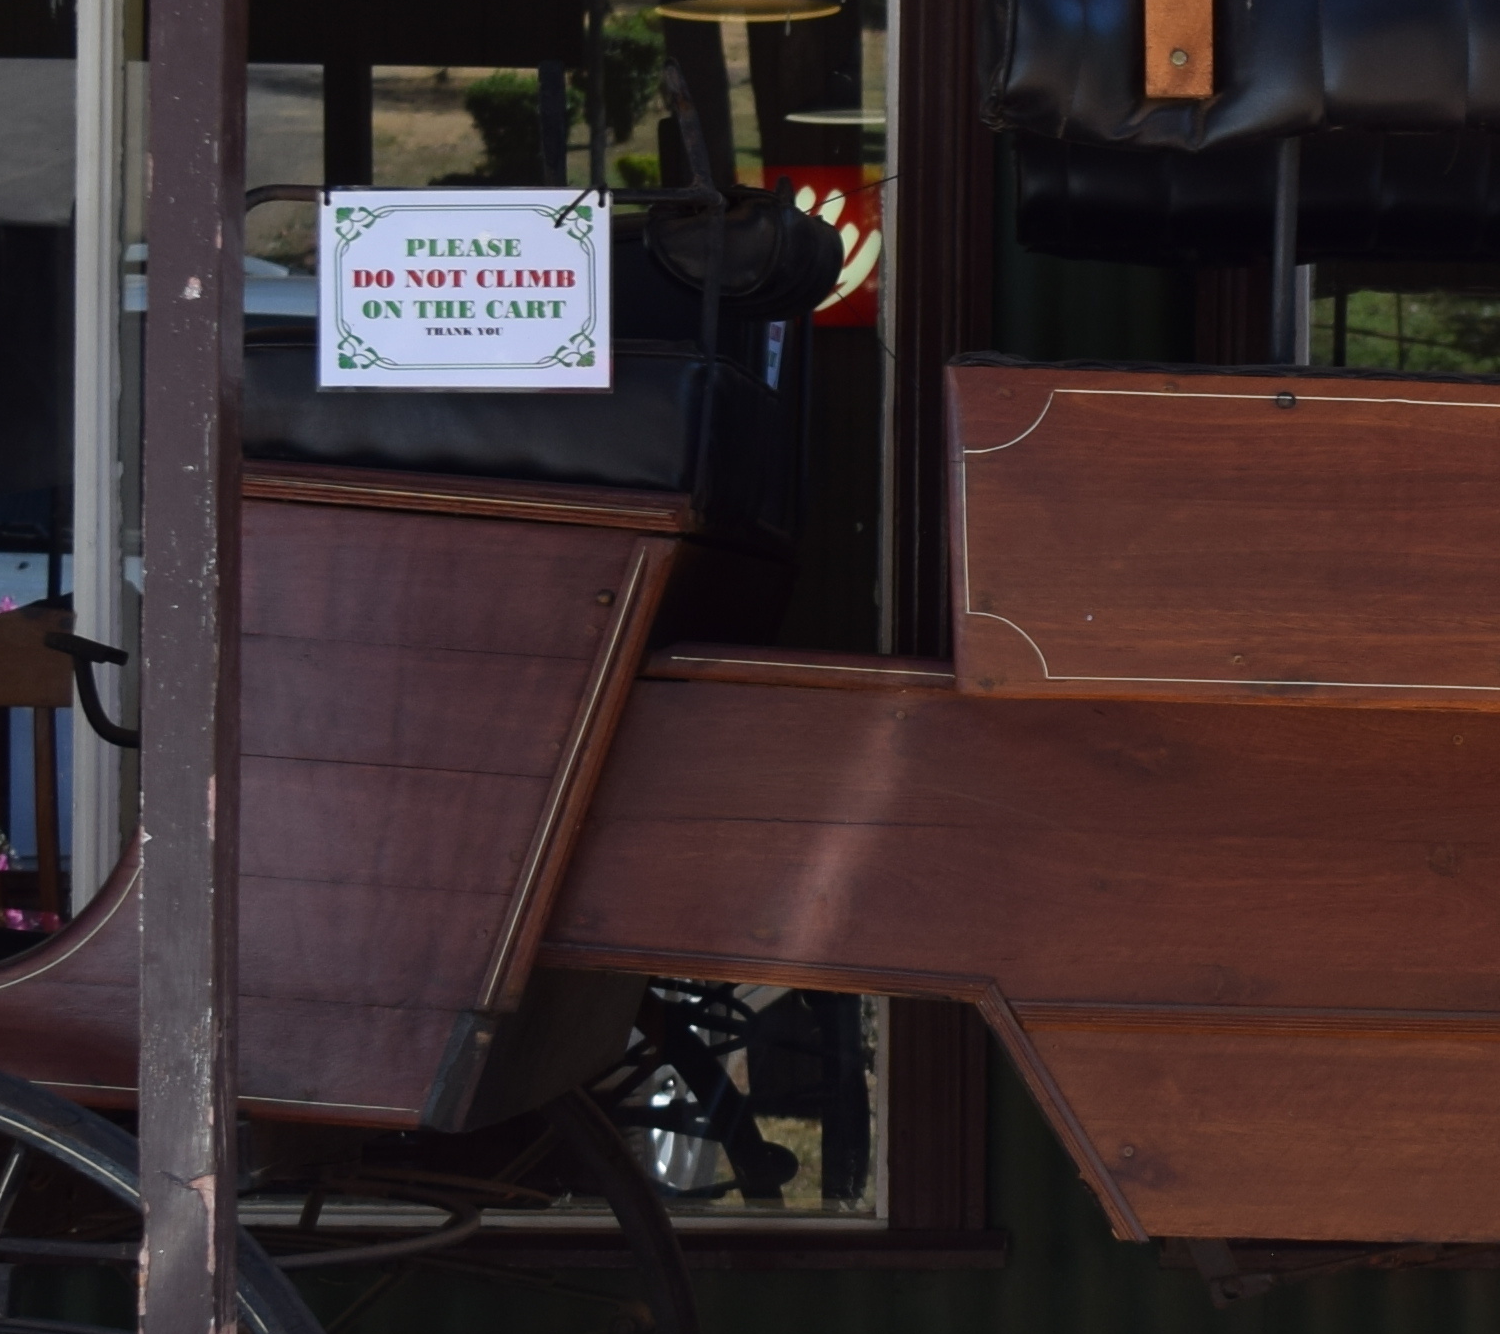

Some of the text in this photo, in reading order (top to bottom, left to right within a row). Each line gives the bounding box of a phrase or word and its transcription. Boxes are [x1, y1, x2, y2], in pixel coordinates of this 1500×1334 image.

[405, 238, 522, 258] PLEASE
[352, 269, 577, 288] DO NOT CLIMB
[362, 300, 567, 319] ON THE CART
[425, 326, 504, 336] THANK YOU
